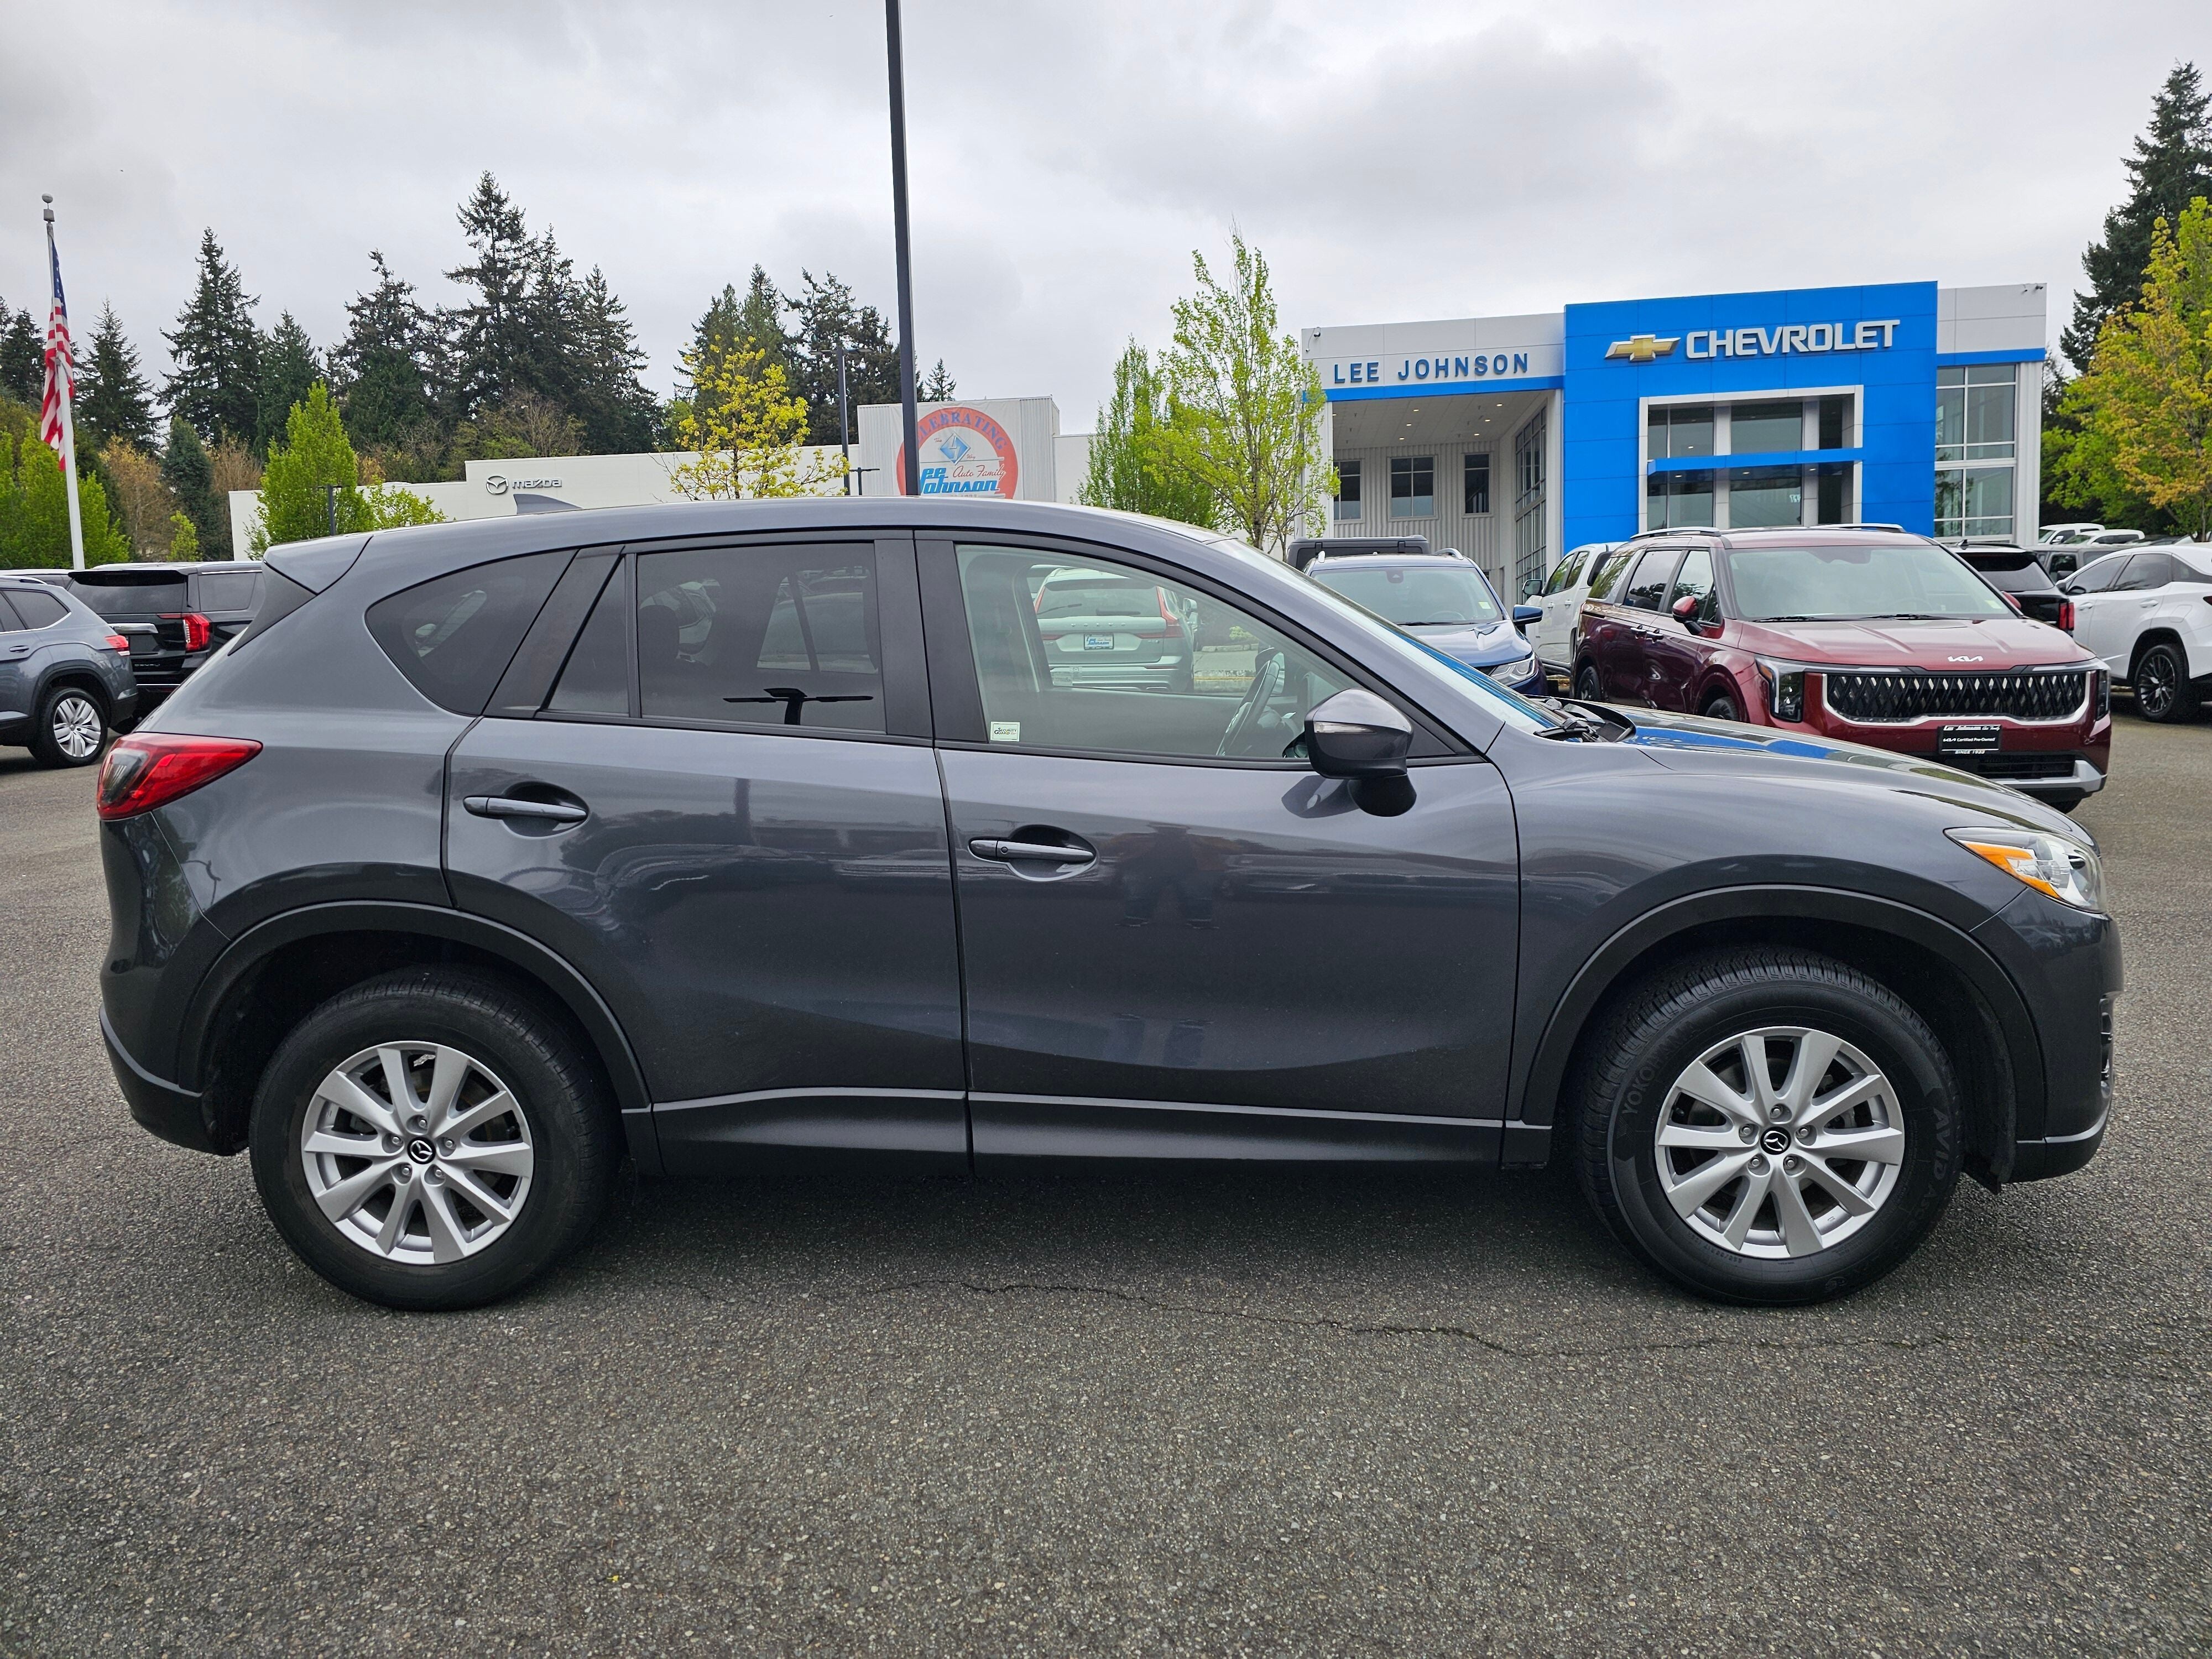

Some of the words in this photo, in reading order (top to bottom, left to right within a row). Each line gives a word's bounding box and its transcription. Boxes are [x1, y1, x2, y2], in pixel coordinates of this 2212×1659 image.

[1686, 319, 1900, 358] CHEVROLET
[1334, 362, 1379, 384] LEE
[1398, 353, 1528, 380] JOHNSON
[919, 411, 1008, 450] LEBRATING
[512, 478, 562, 489] mazda
[953, 465, 974, 478] Auto
[976, 463, 1006, 482] Family
[1622, 1019, 1700, 1114] YOKOHAMA
[1933, 1108, 1950, 1181] AVID
